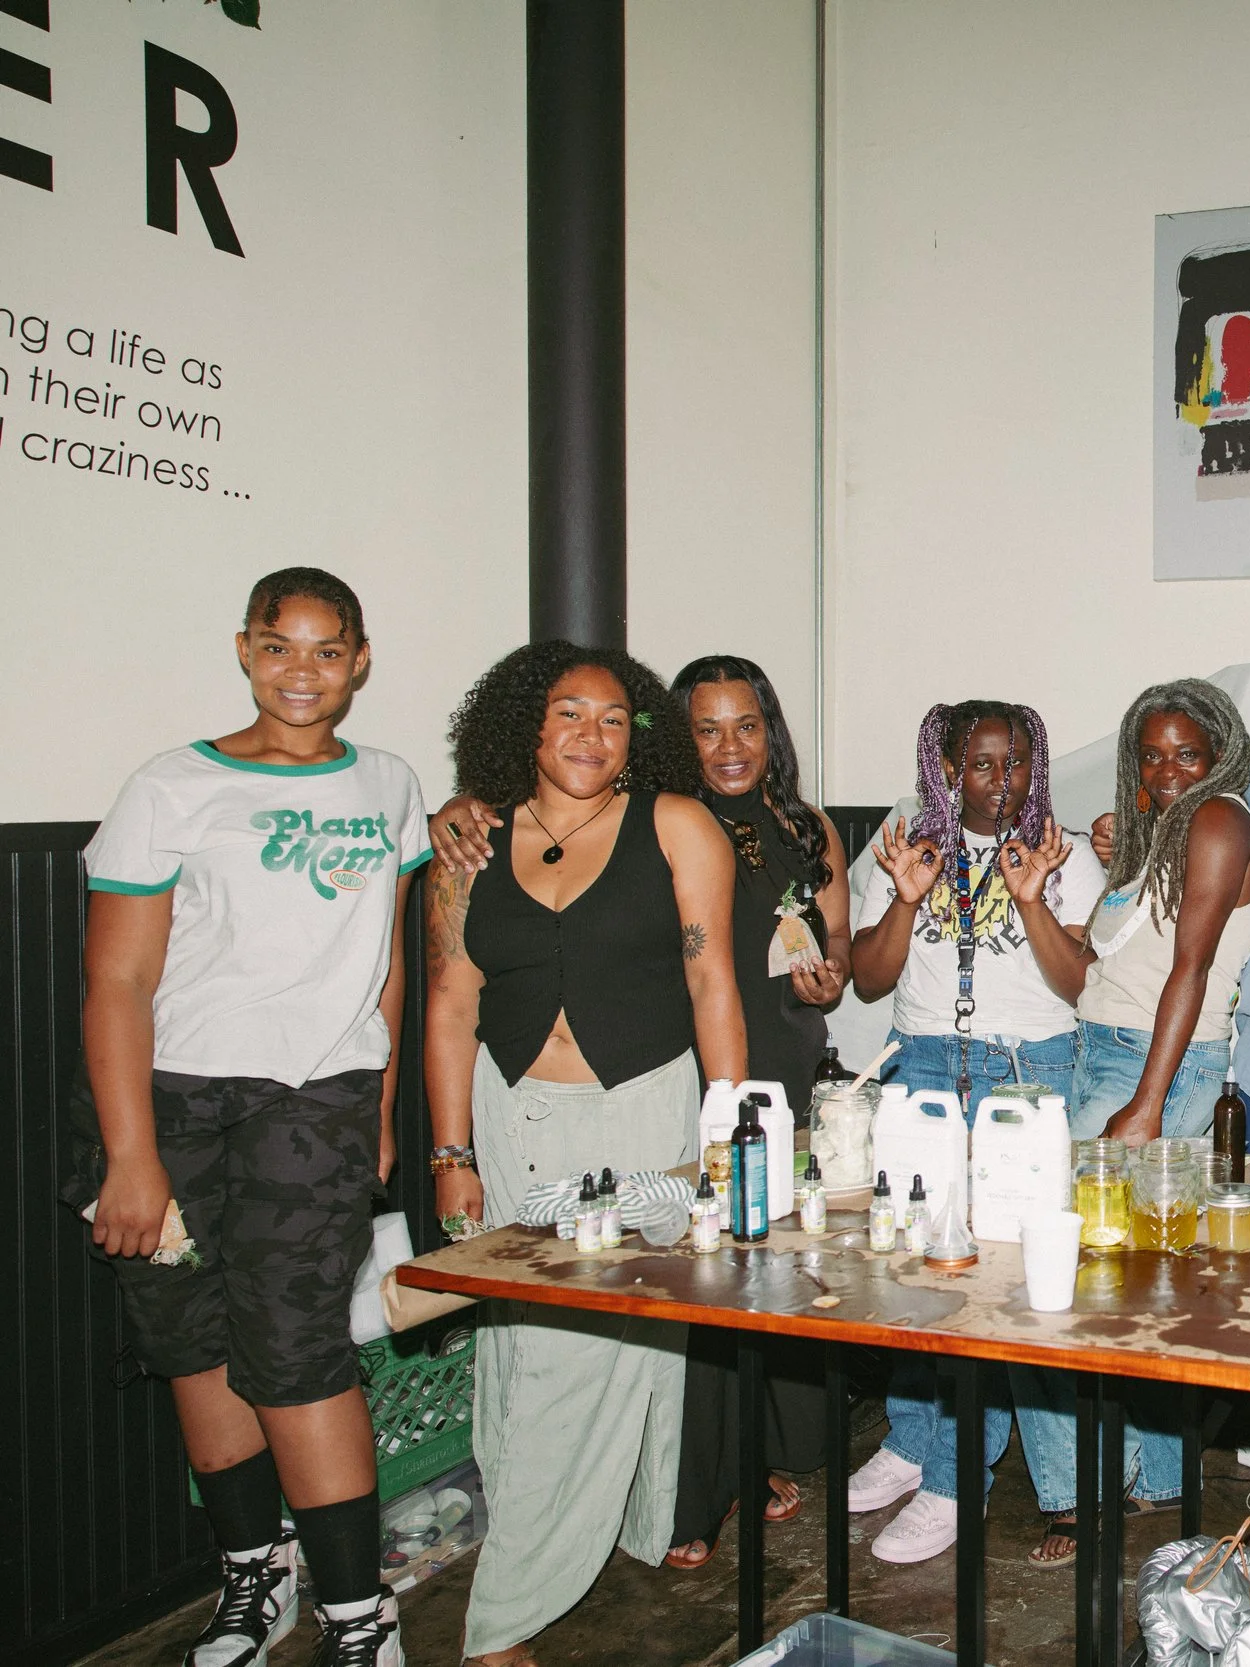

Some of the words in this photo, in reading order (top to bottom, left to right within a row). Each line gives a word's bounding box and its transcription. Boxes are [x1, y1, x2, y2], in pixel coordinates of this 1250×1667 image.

[67, 329, 94, 357] a
[111, 329, 165, 374] life
[182, 359, 221, 389] as
[30, 367, 125, 418] their
[139, 402, 220, 441] own
[22, 434, 209, 491] craziness
[250, 809, 395, 852] Plant
[261, 837, 387, 900] Mom
